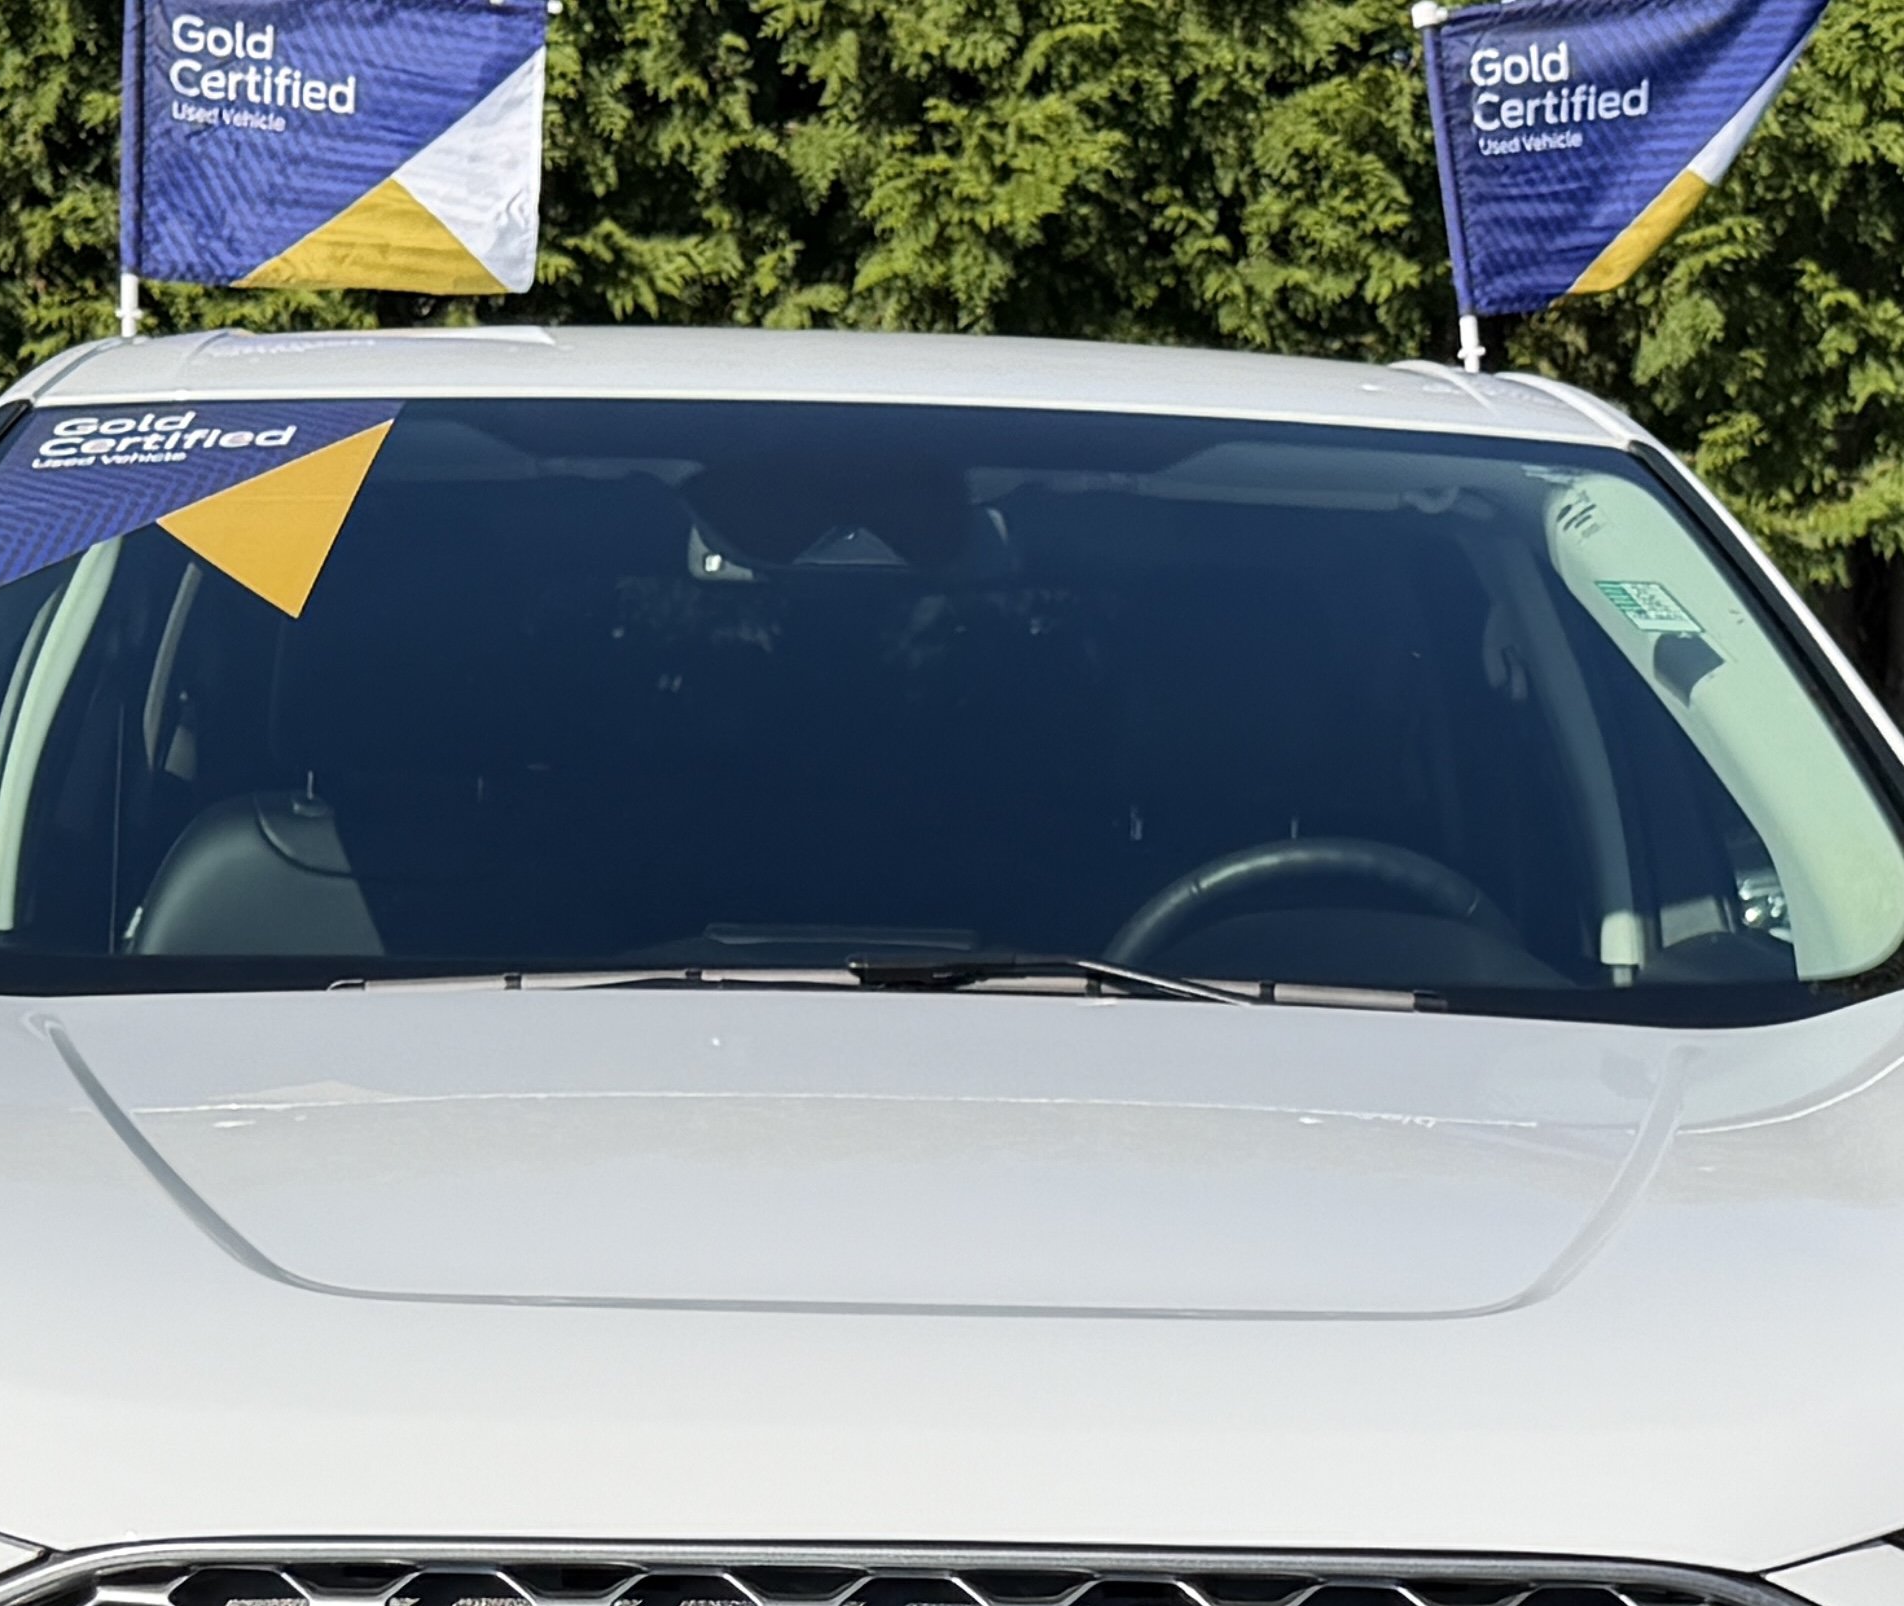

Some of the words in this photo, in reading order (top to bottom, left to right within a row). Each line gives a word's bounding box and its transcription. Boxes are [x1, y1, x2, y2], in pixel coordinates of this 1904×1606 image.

[171, 14, 275, 61] Gold
[1469, 41, 1570, 87] Gold
[169, 58, 357, 115] Certified
[171, 100, 220, 124] Used
[222, 105, 286, 133] Vehicle
[1472, 77, 1650, 131] Certified
[1478, 136, 1521, 156] Used
[1521, 130, 1584, 152] Vehicle
[52, 410, 197, 437] Gold
[39, 425, 297, 457] Certified
[31, 454, 96, 469] Used
[100, 451, 188, 466] Vehicle
